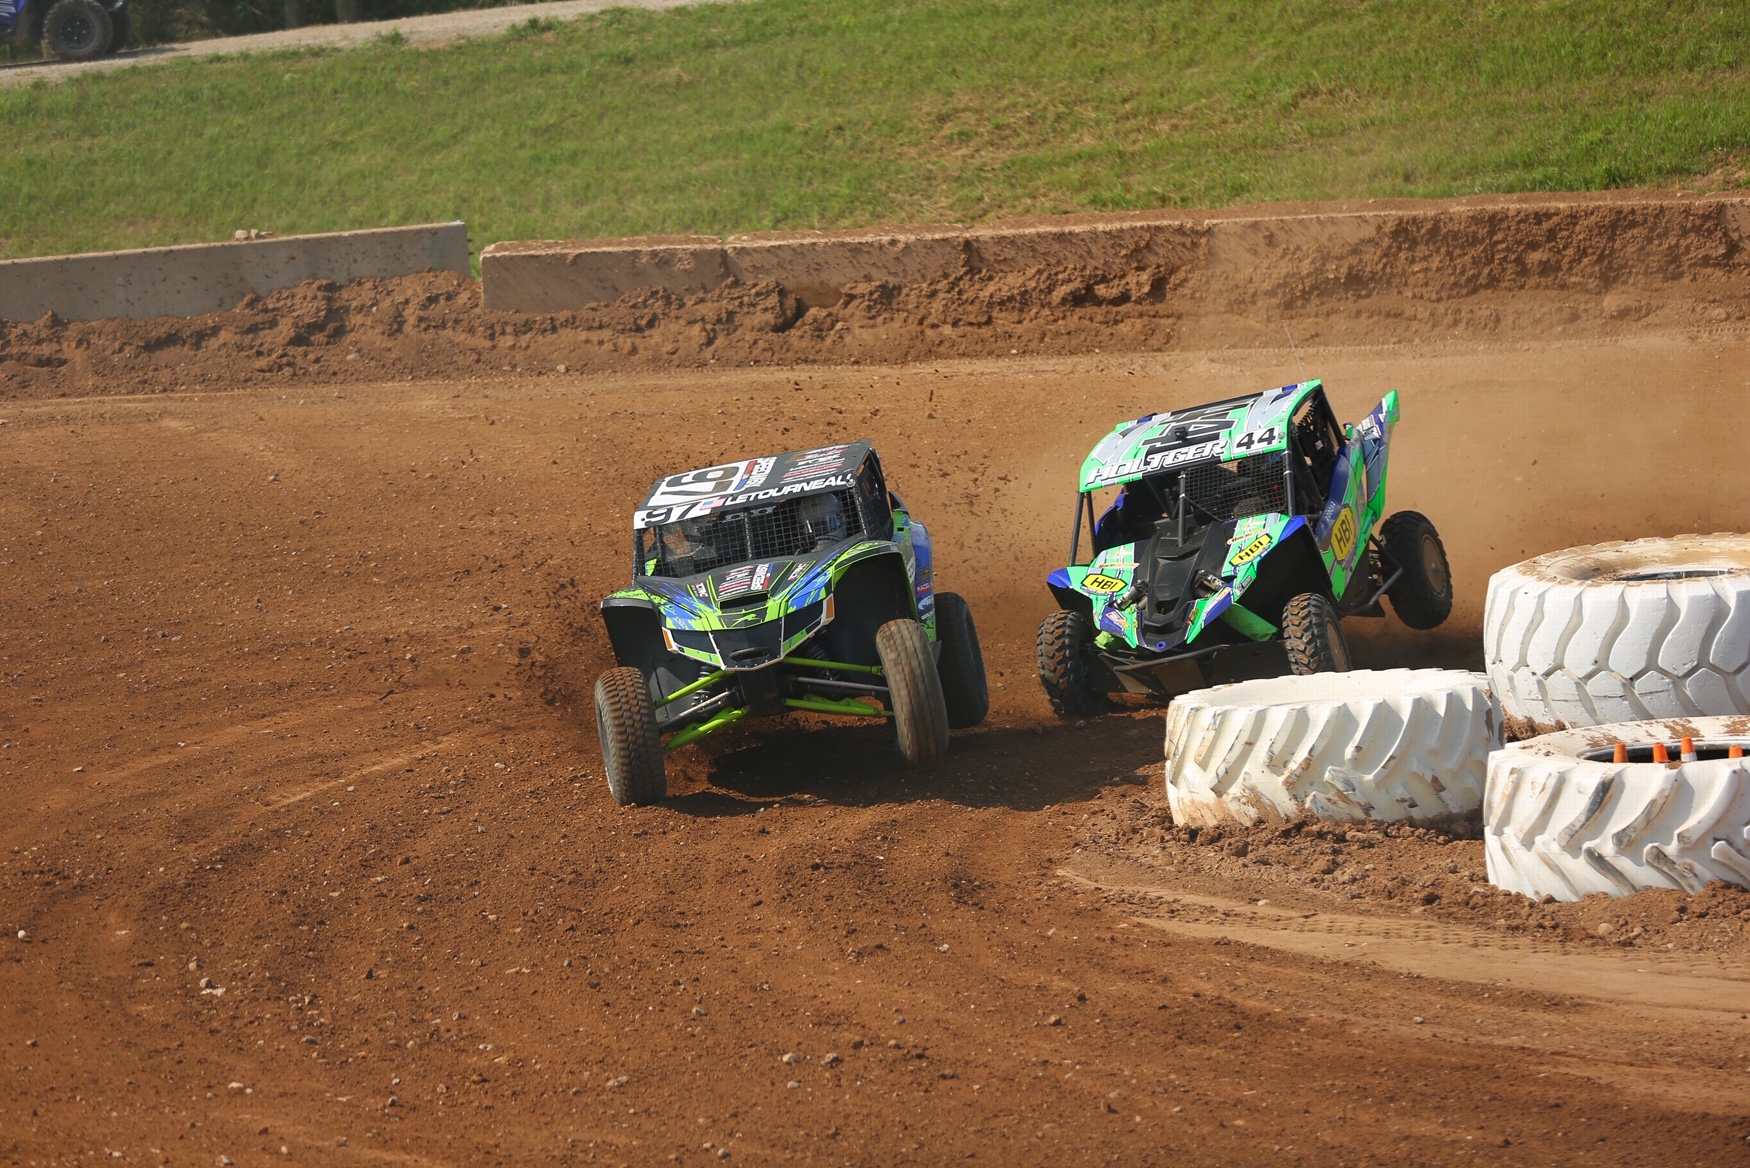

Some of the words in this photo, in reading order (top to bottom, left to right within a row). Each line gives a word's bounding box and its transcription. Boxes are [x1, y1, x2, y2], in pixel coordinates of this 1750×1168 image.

[1236, 427, 1276, 449] 44
[1086, 439, 1227, 484] HOLTGER
[724, 473, 854, 506] LETOURNEAU
[645, 500, 701, 526] 97
[1335, 514, 1353, 554] HBI
[1238, 541, 1263, 560] HBI
[1090, 577, 1118, 590] HBI
